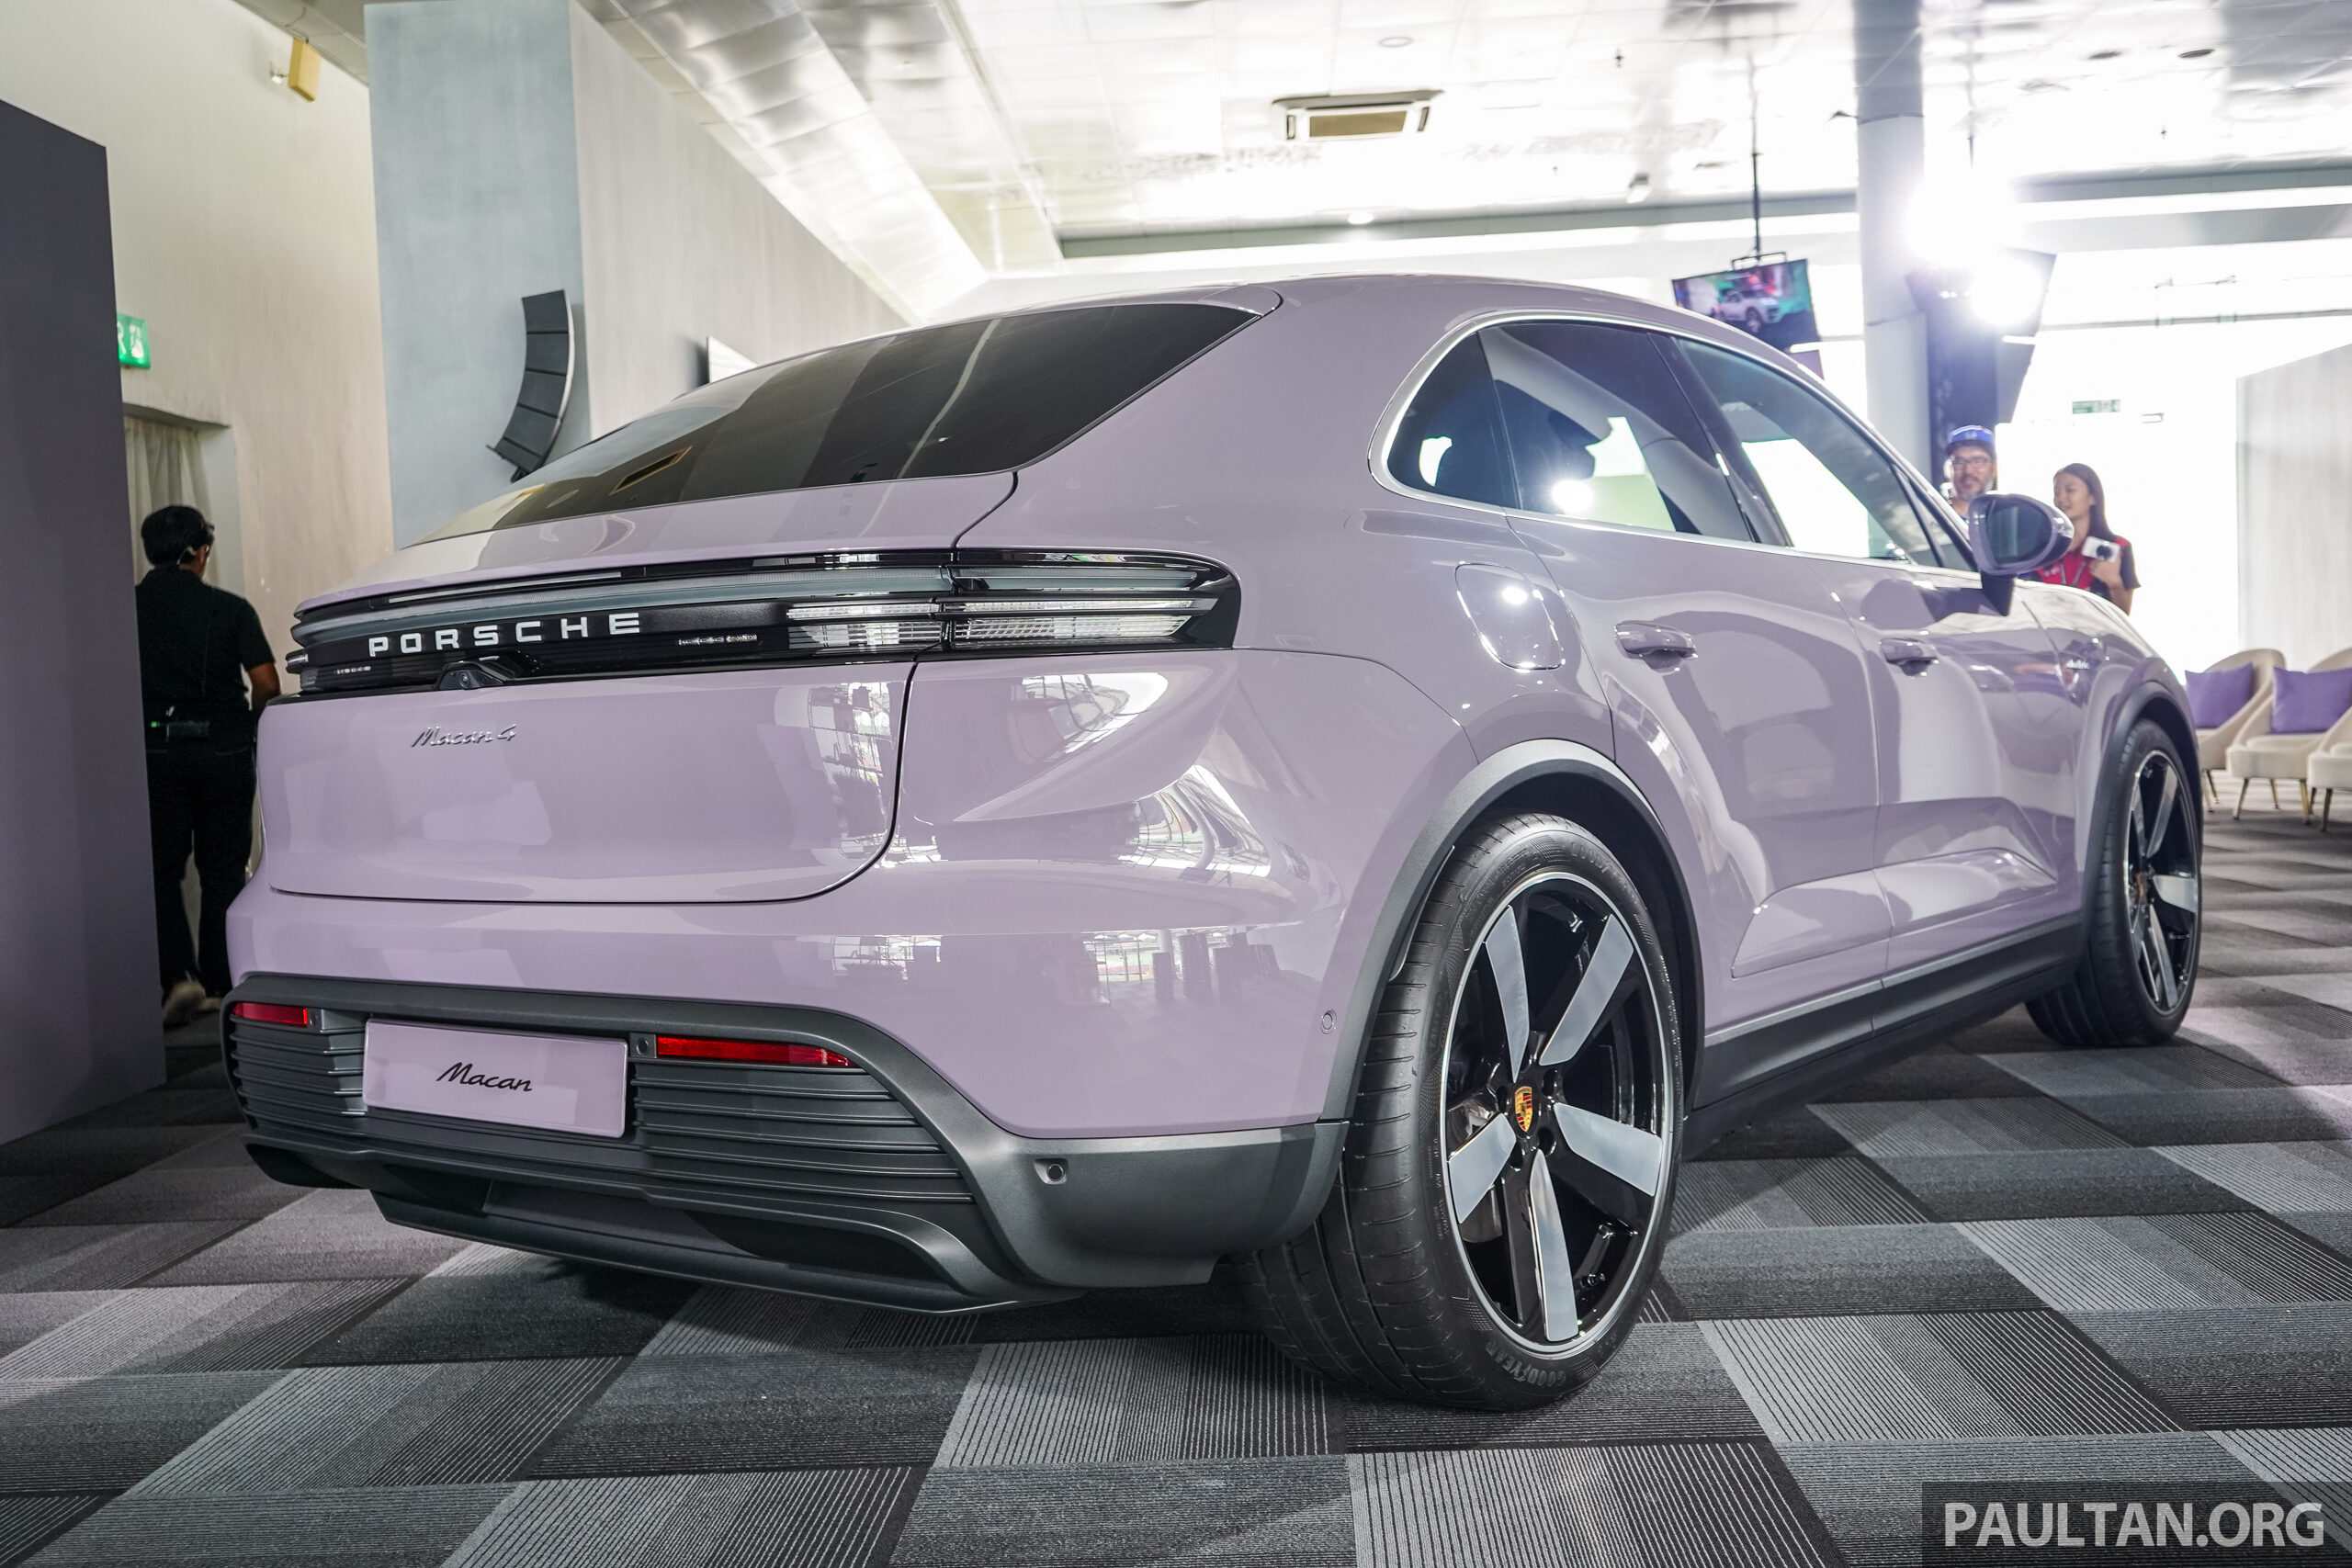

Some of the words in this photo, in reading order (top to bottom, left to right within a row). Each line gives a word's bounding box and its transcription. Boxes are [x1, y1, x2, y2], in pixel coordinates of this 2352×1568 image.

[368, 612, 640, 657] PORSCHE
[411, 726, 493, 748] Macan
[497, 724, 517, 741] 4
[435, 1061, 533, 1092] Macan
[1485, 1340, 1566, 1388] GOODYEAR
